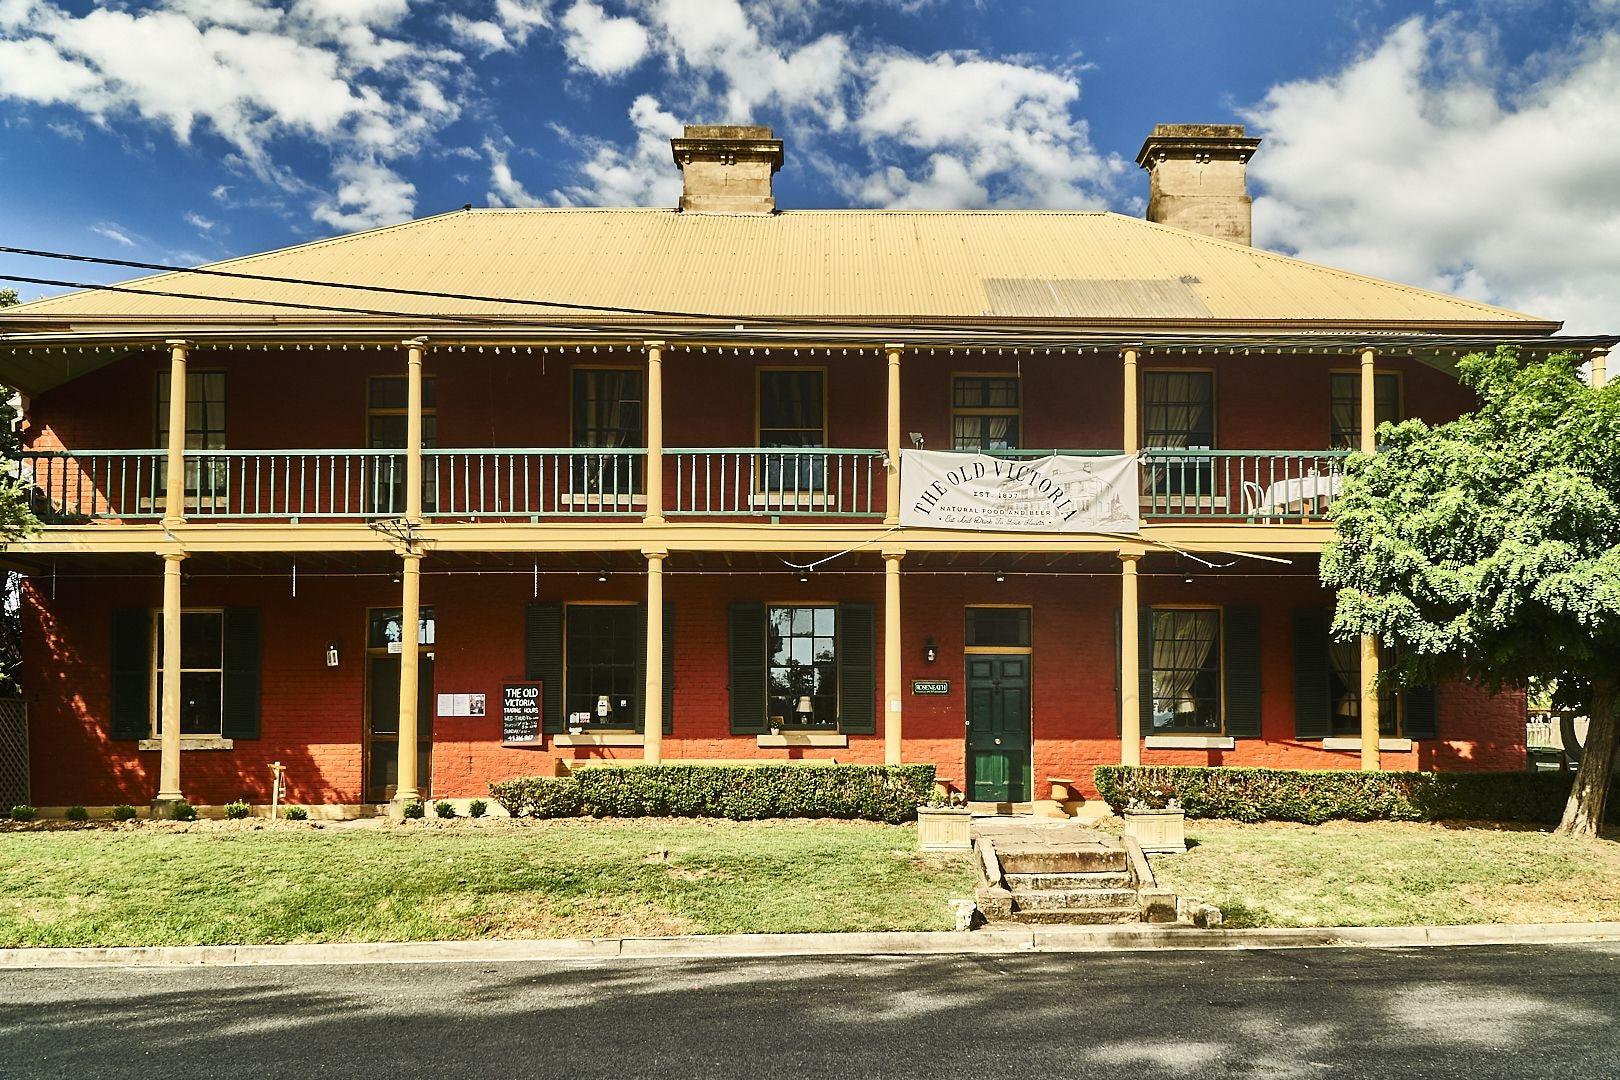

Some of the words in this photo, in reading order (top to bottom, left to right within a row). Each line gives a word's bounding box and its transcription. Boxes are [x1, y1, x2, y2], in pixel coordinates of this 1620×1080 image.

[914, 480, 948, 515] THE
[946, 462, 985, 485] OLD
[994, 461, 1078, 521] VICTORIA
[940, 505, 979, 513] NATURAL
[957, 515, 971, 524] And
[974, 516, 992, 525] Drink
[1024, 518, 1045, 526] Health
[505, 688, 521, 698] THE
[523, 688, 538, 698] OLD
[504, 698, 536, 706] VICTORIA
